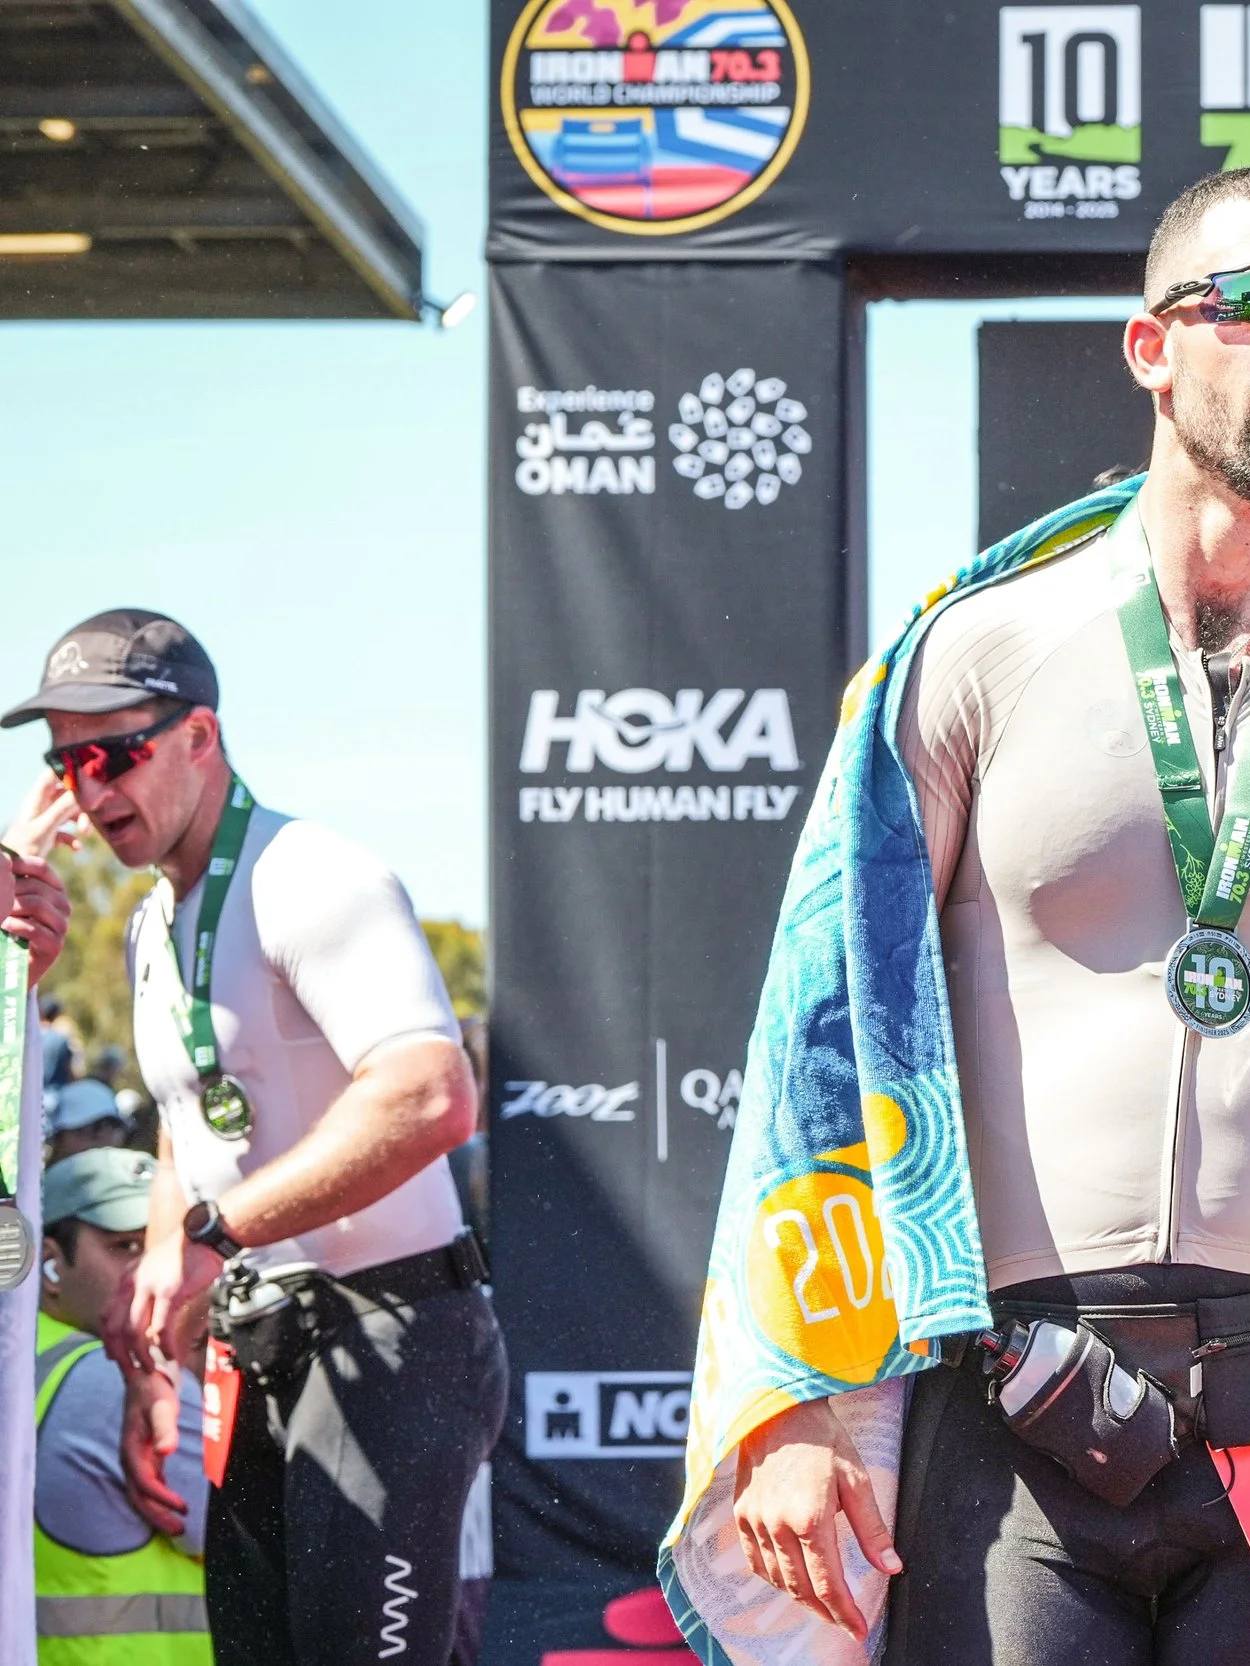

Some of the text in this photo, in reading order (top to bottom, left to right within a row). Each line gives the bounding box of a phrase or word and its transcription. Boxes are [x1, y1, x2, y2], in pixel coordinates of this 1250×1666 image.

[711, 50, 781, 83] 70.3
[1021, 32, 1118, 133] 10
[530, 81, 781, 106] WORLD CHAMPIONSHIP
[1000, 165, 1142, 200] YEARS
[517, 385, 655, 416] Experience
[515, 456, 656, 496] OMAN
[519, 688, 800, 773] HOKA
[1144, 701, 1162, 744] SYDNEY
[519, 785, 799, 823] FLY HUMAN FLY
[1216, 817, 1250, 900] IRONMAN
[1229, 870, 1250, 904] 70.3
[680, 1068, 745, 1115] QA
[609, 1391, 692, 1440] NO
